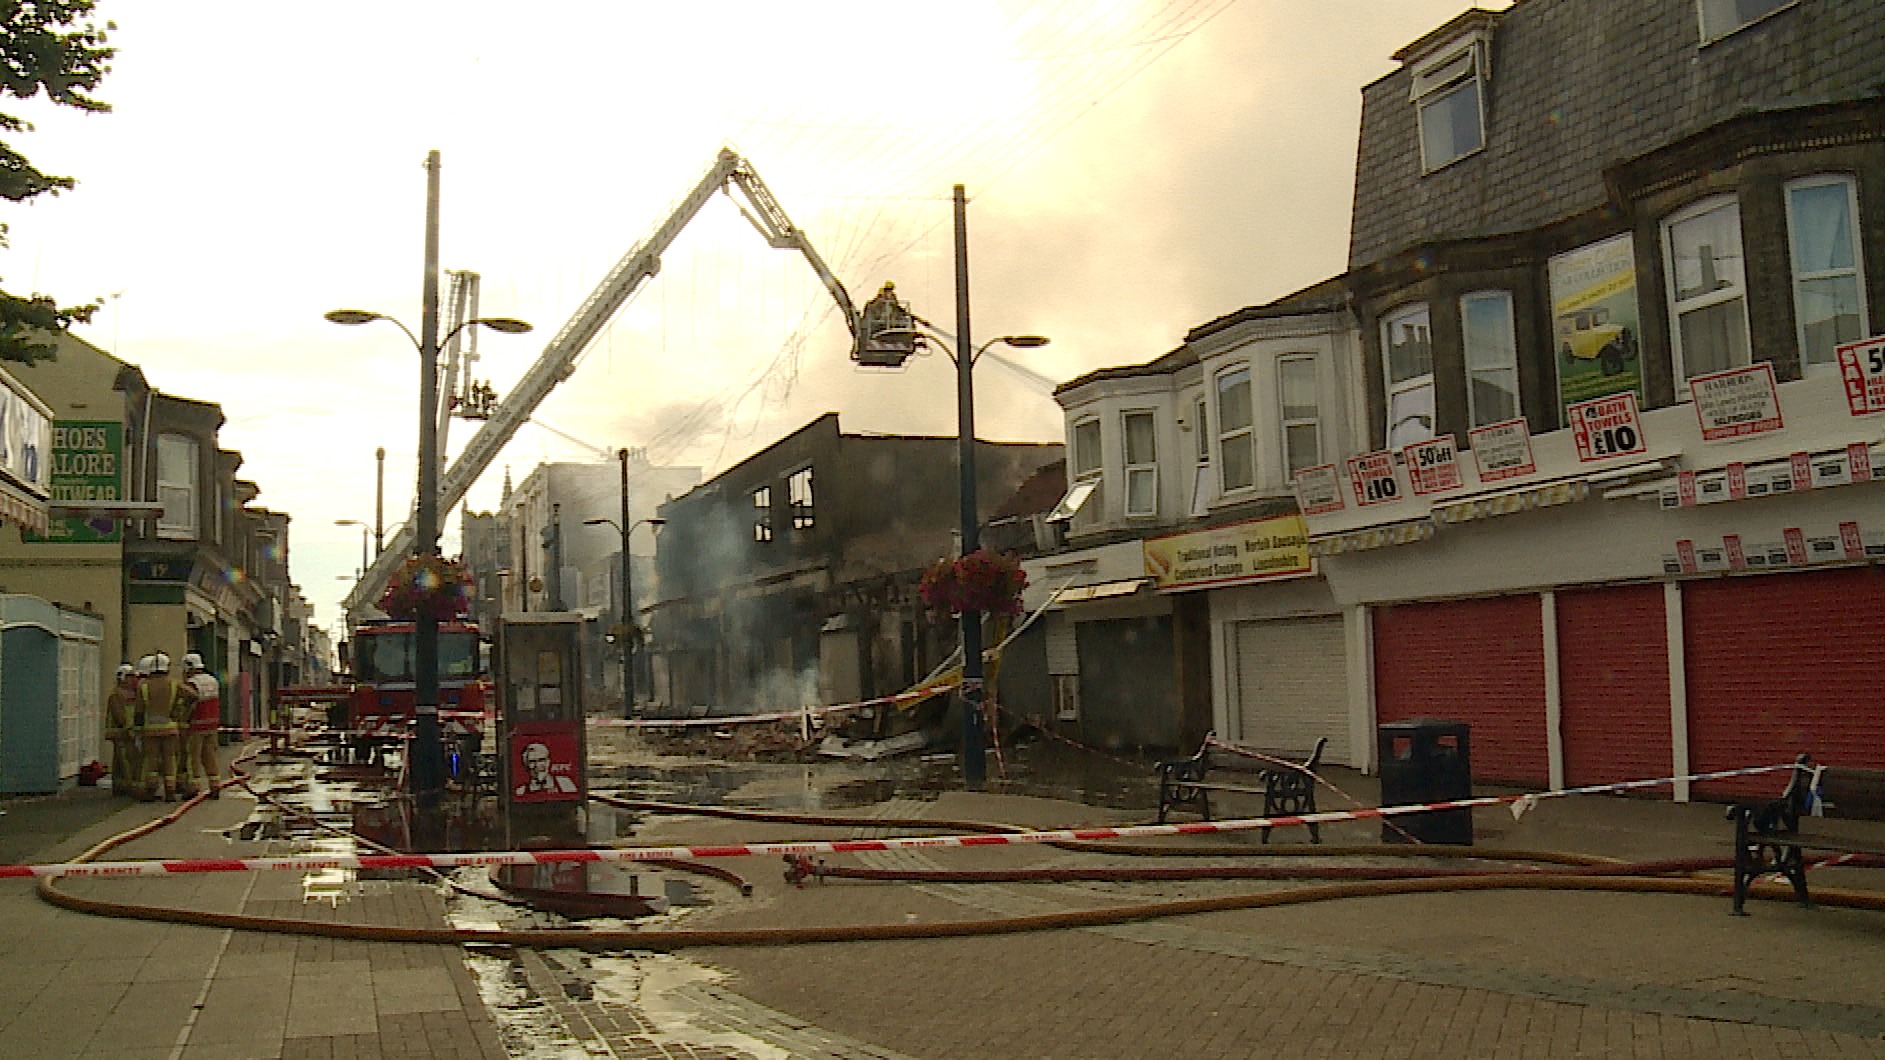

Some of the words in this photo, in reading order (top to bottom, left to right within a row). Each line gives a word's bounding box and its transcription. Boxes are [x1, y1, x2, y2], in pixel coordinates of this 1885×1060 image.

[1868, 347, 1885, 374] 5
[1598, 401, 1627, 416] BATH
[1587, 411, 1632, 431] TOWELS
[52, 427, 107, 450] HOES
[1595, 426, 1636, 455] £10
[50, 453, 115, 475] ALORE
[51, 485, 117, 501] OTWEAR
[1367, 477, 1396, 501] £10
[550, 762, 572, 773] KFC
